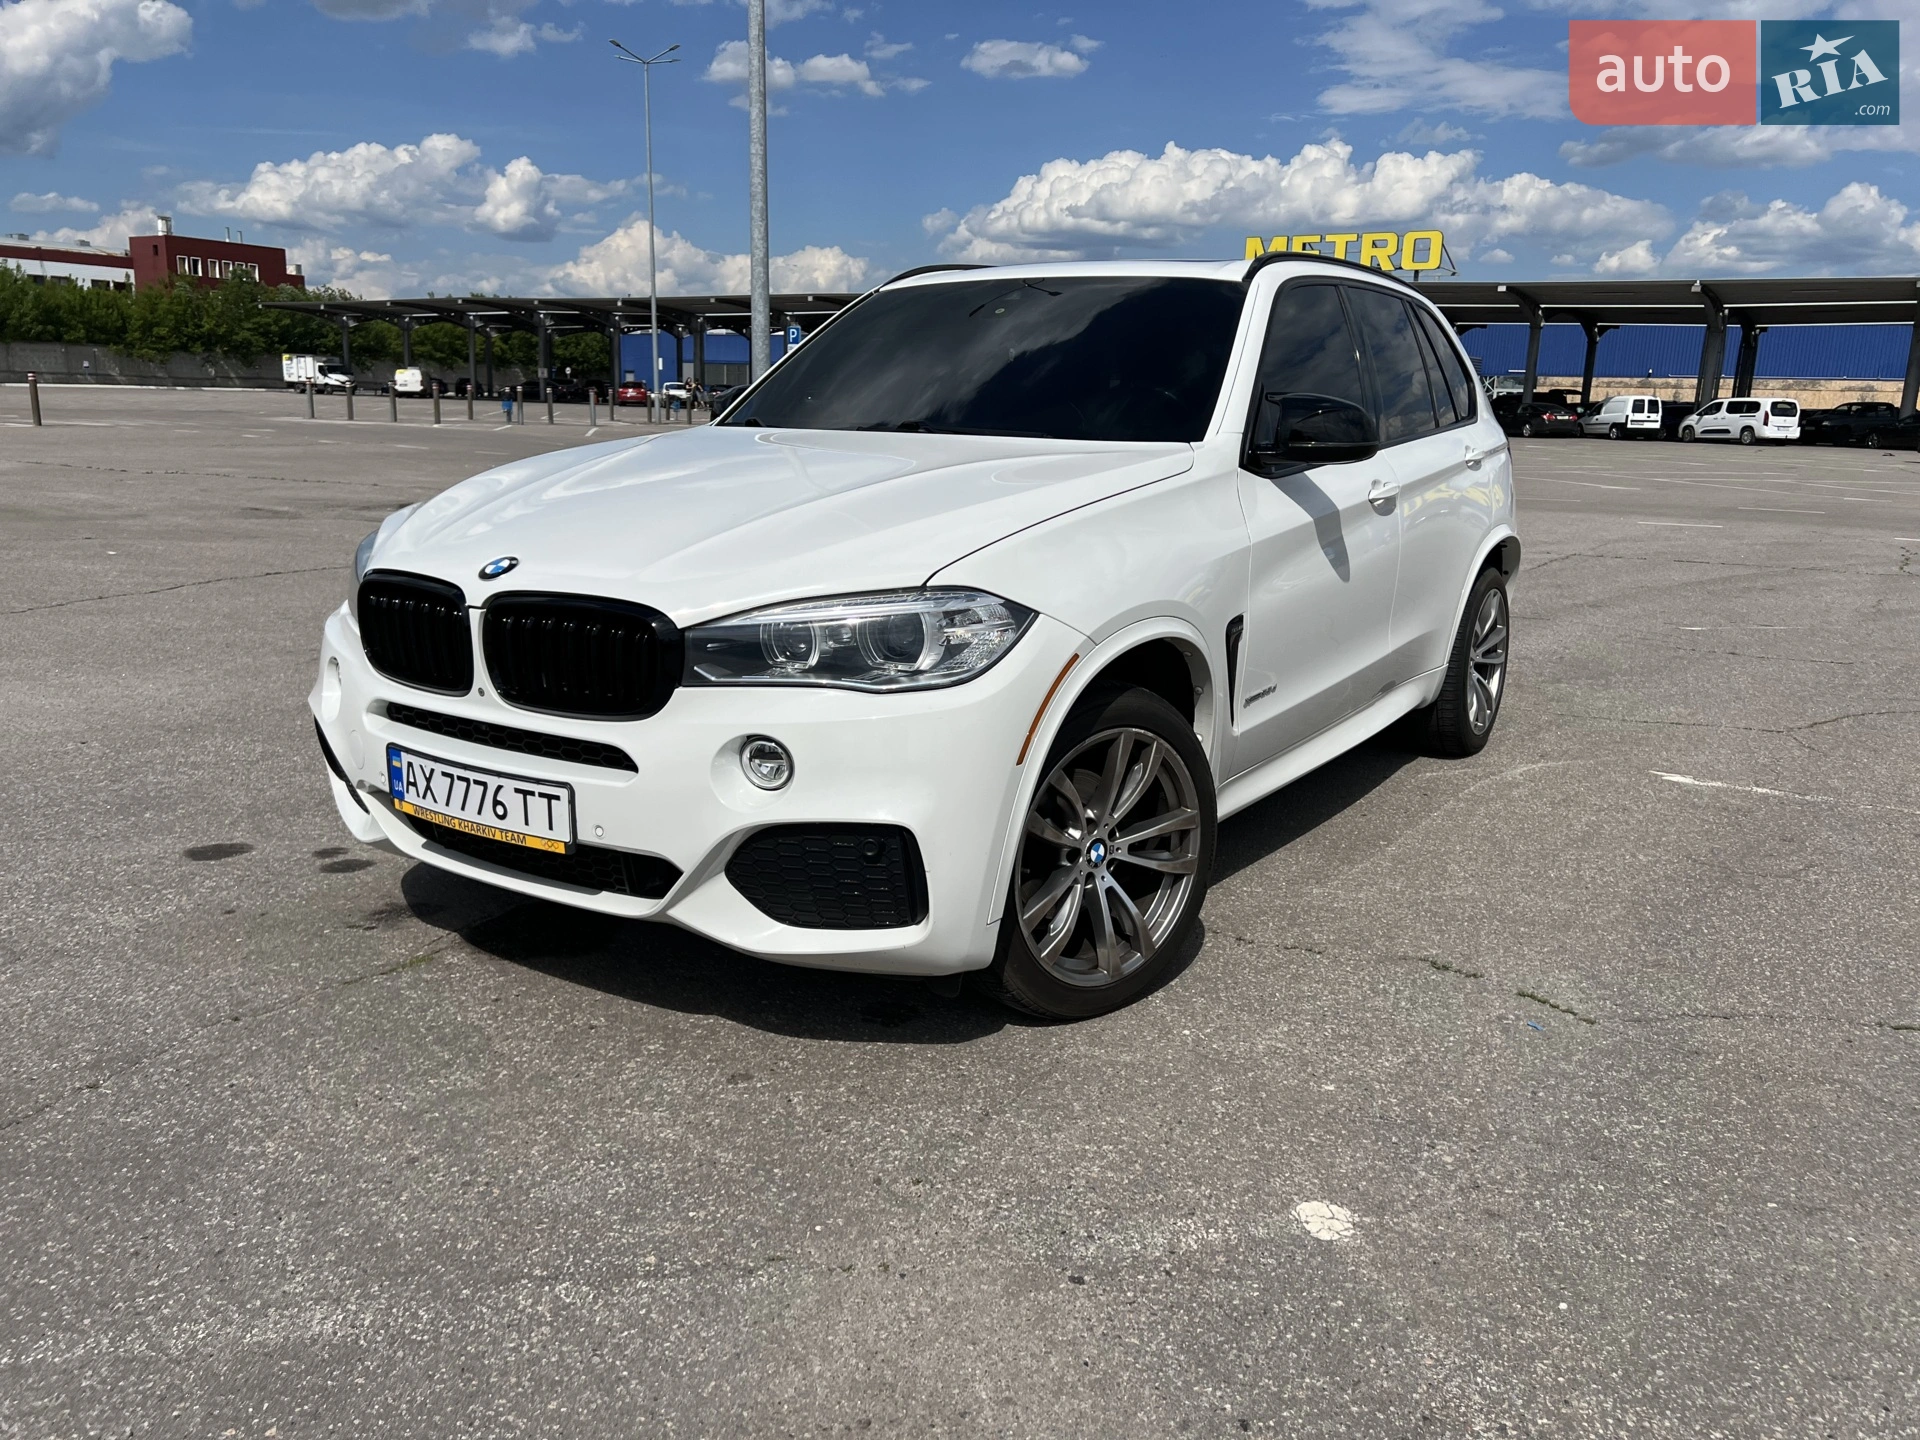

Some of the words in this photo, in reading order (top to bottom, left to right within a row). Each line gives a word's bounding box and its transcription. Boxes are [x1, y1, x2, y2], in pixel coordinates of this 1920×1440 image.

[789, 328, 798, 343] P
[394, 779, 404, 792] UA
[413, 806, 456, 828] WRESTLING
[458, 818, 497, 838] KHARKIV
[499, 830, 527, 845] TEAM
